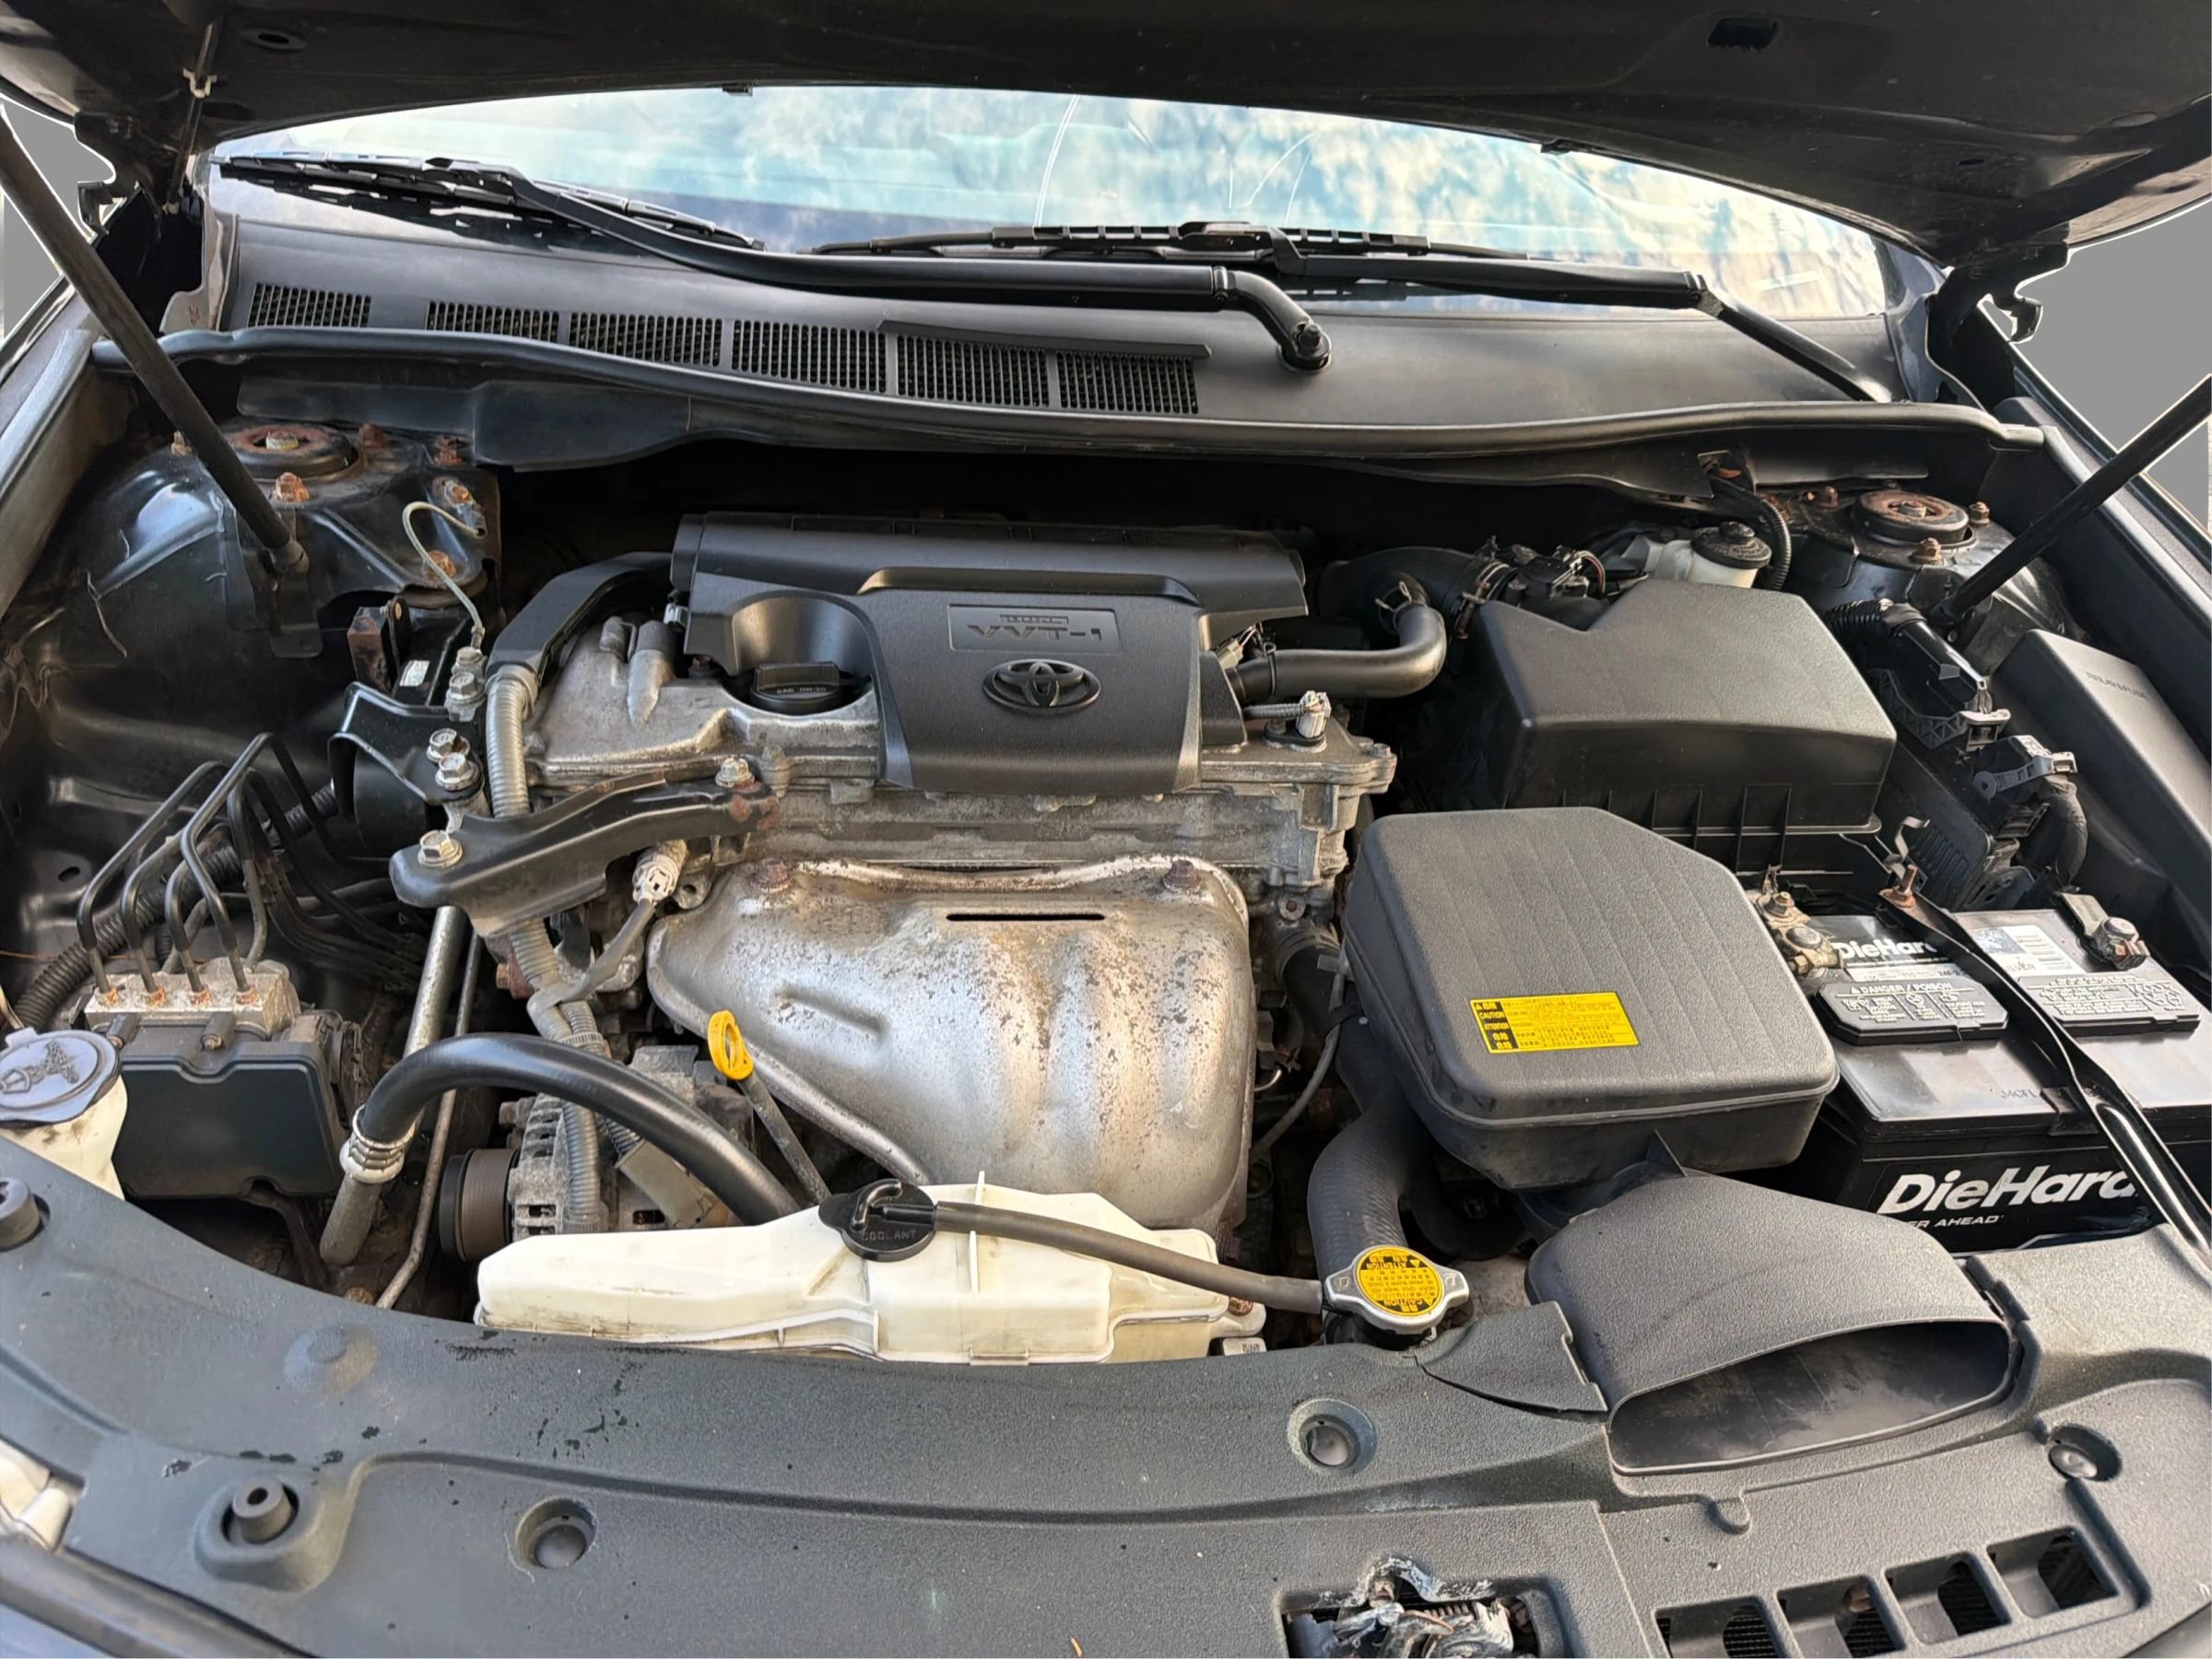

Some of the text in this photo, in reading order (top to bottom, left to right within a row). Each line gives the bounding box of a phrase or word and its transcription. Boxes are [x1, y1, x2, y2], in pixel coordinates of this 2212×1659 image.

[1860, 984, 1905, 994] DANGER
[1912, 982, 1953, 992] POISON
[1478, 1010, 1505, 1019] CAUTION
[1934, 1215, 1999, 1228] AHEAD
[861, 1230, 916, 1241] COOLANT
[1383, 1297, 1423, 1306] CAUTION
